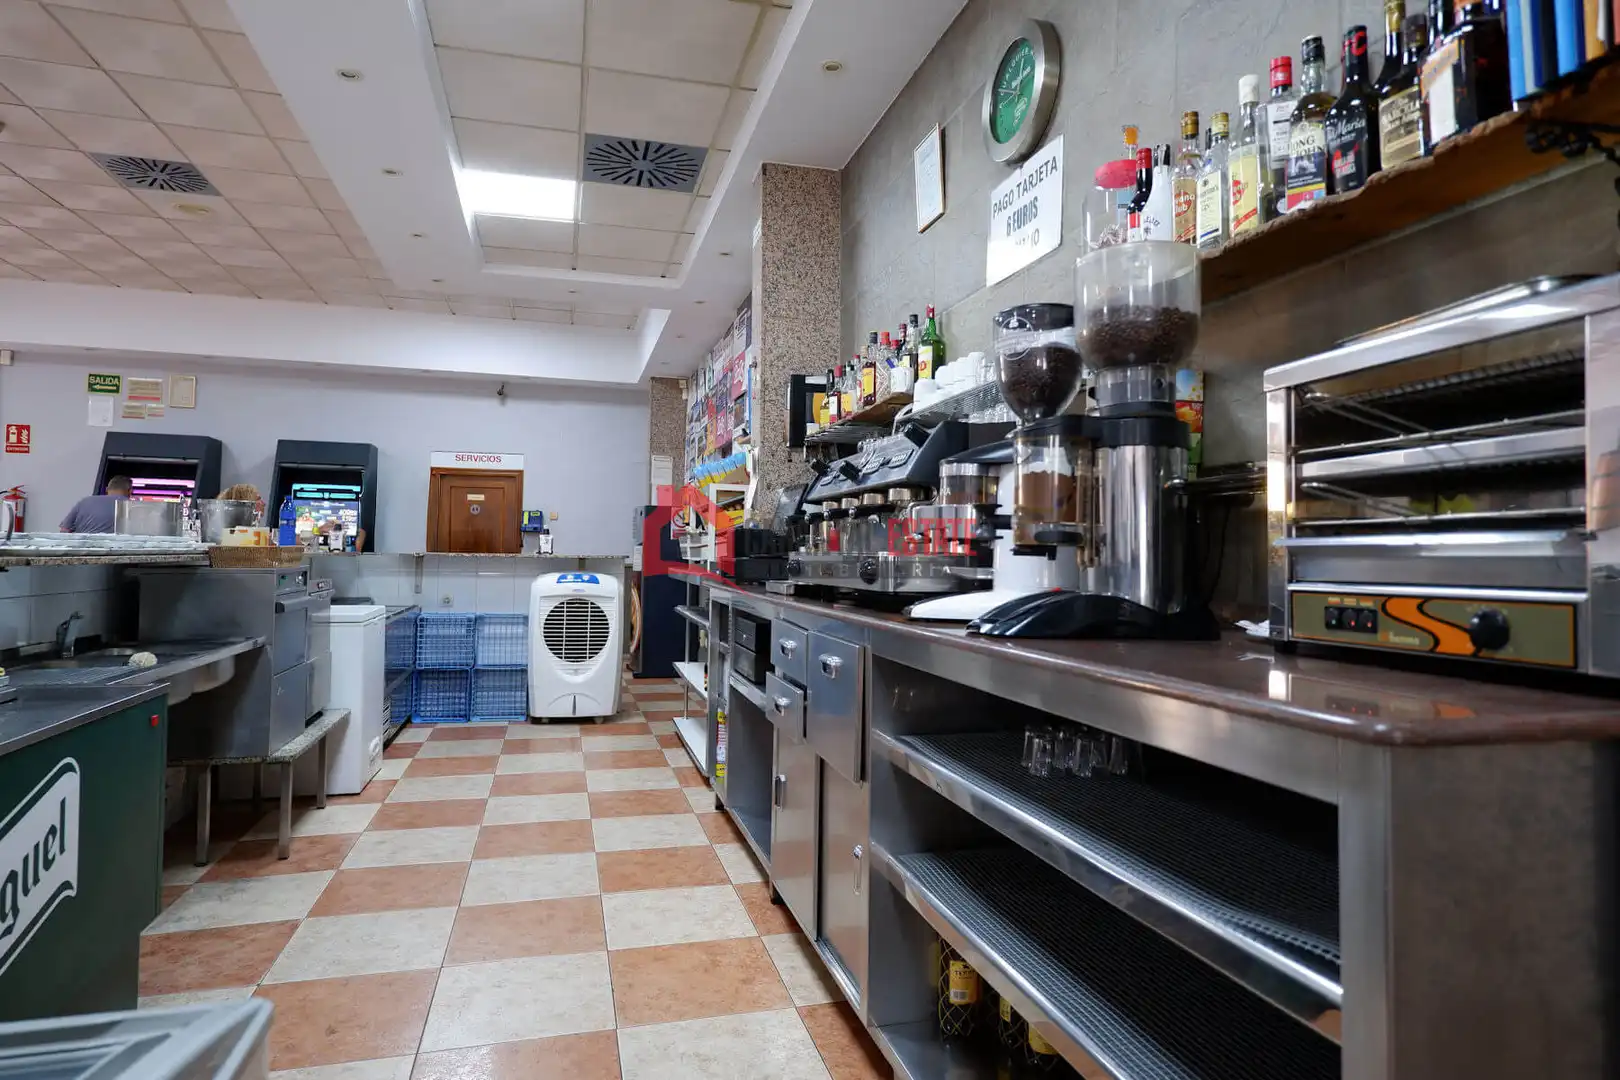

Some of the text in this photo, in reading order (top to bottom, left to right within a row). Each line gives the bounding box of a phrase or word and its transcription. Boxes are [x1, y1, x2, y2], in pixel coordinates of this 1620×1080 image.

[993, 156, 1058, 220] PAGO TARJETA
[1012, 196, 1038, 232] EUROS
[88, 375, 120, 386] SALIDA
[455, 454, 502, 463] SERVICIOS
